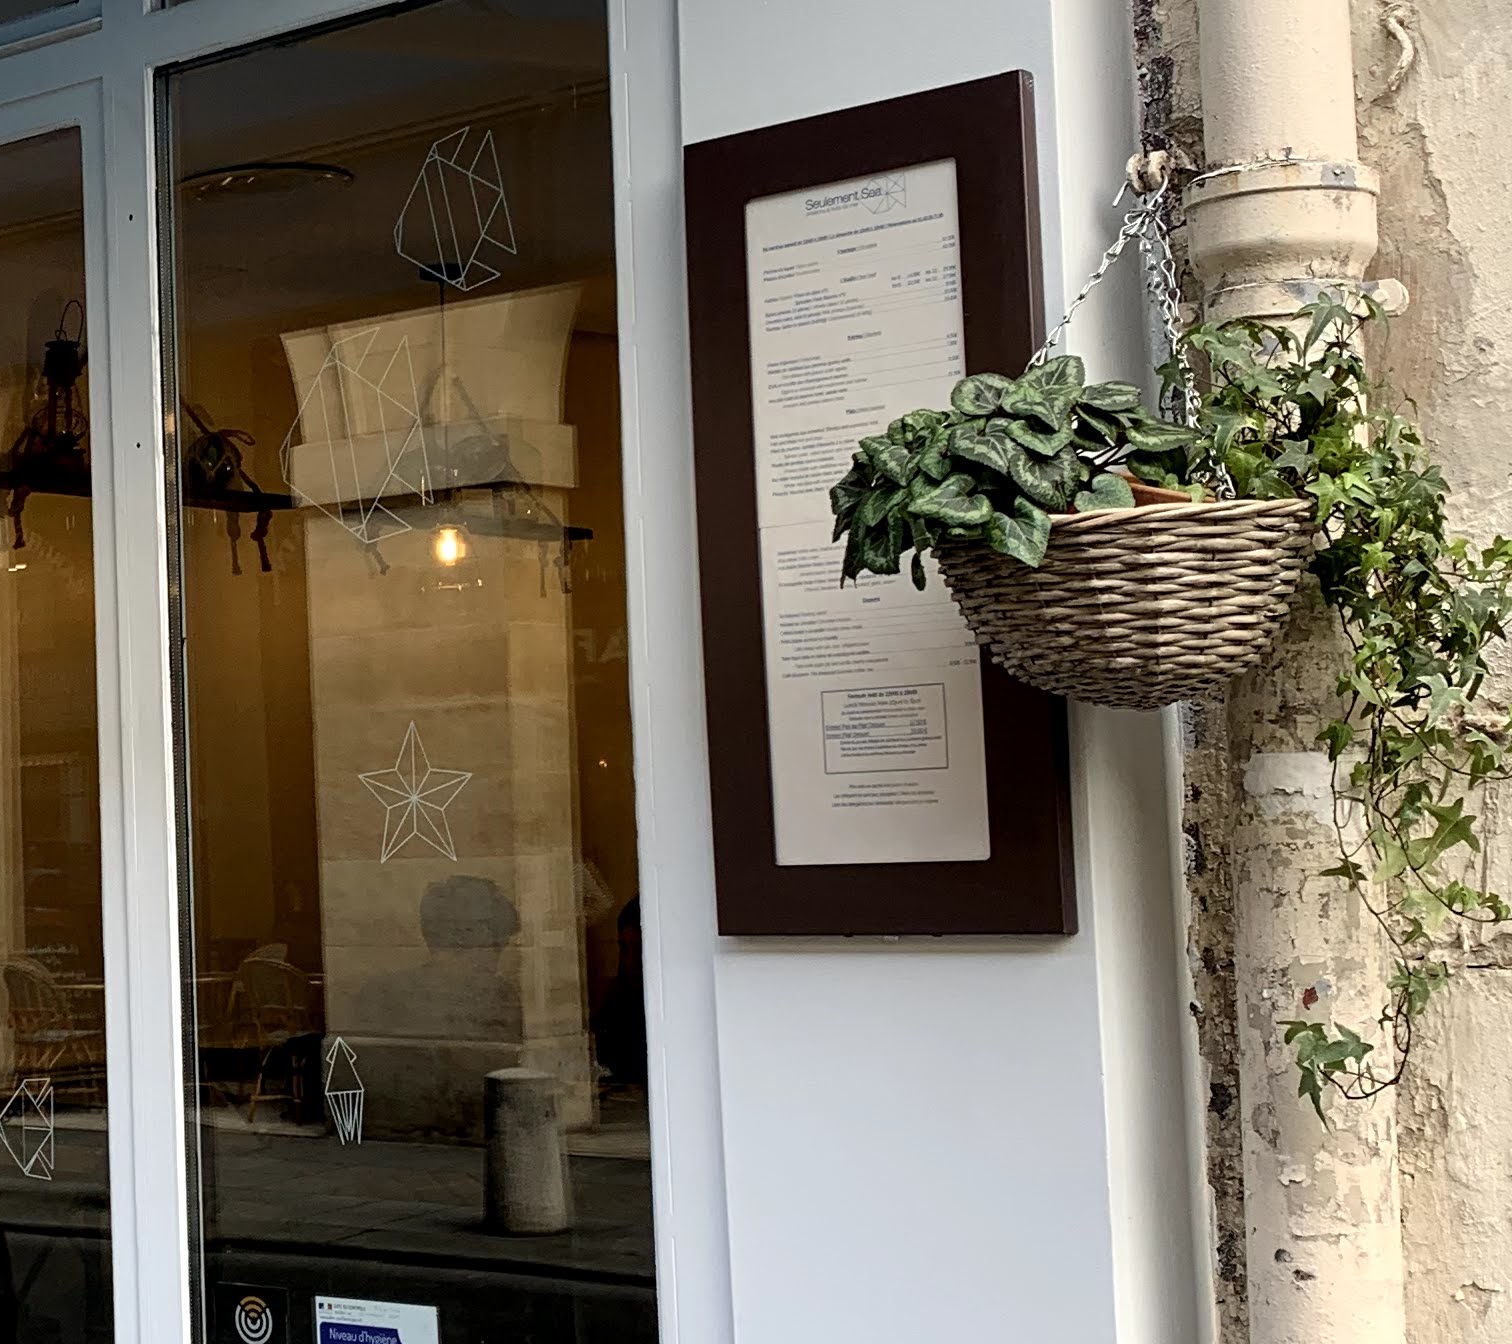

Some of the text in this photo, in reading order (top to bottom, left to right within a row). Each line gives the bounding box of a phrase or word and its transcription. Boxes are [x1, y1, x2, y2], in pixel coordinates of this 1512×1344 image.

[805, 190, 859, 212] Seulement
[861, 186, 883, 200] Sea
[329, 1327, 357, 1342] Niveau
